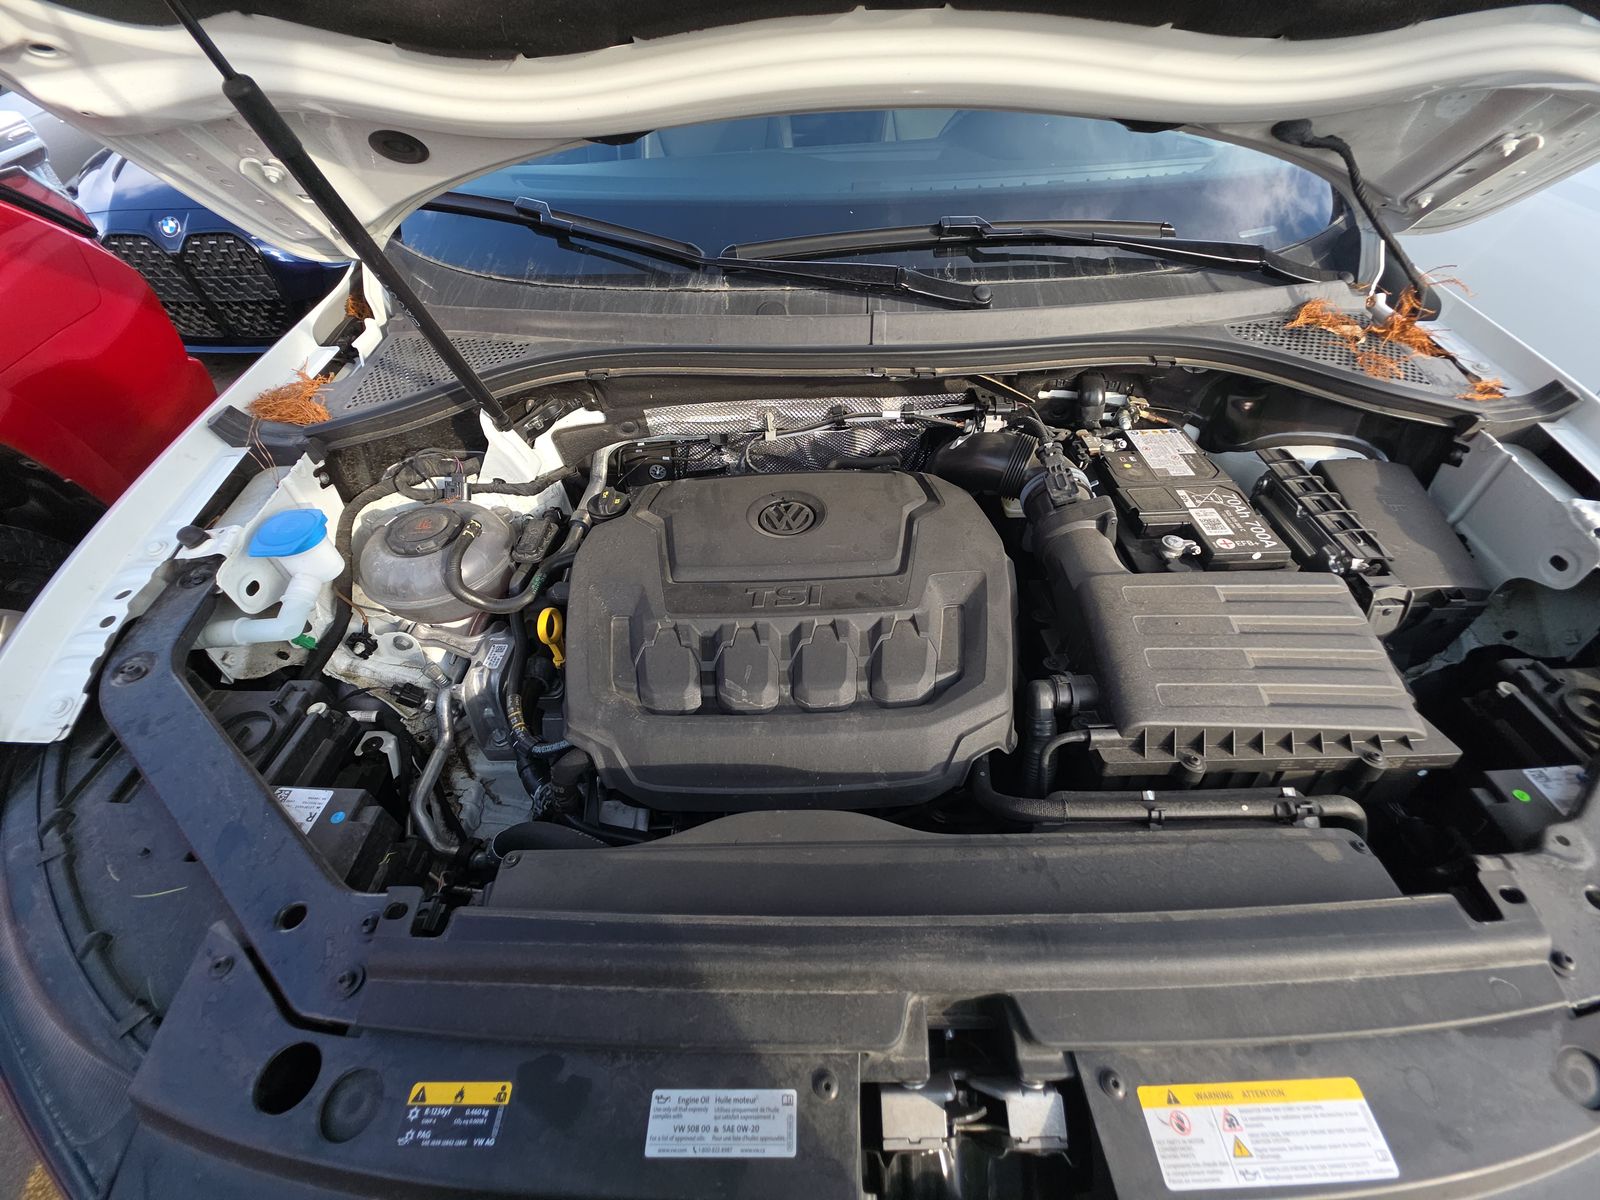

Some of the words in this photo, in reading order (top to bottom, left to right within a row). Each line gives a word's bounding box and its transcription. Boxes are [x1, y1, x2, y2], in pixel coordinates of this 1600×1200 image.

[1222, 493, 1251, 518] 70Ah
[1245, 520, 1278, 548] 700A
[745, 584, 823, 608] TSI
[305, 812, 318, 822] R
[1194, 1091, 1234, 1100] WARNING
[1241, 1088, 1286, 1098] ATTENTION
[677, 1096, 699, 1106] Engine
[700, 1096, 710, 1104] Oil
[715, 1096, 731, 1104] Huile
[424, 1107, 453, 1118] R-1234yf
[673, 1125, 686, 1133] VW
[687, 1125, 700, 1133] 508
[700, 1125, 711, 1133] 00
[713, 1125, 719, 1133] &
[722, 1125, 735, 1133] SAE
[736, 1125, 760, 1133] 0W-20
[416, 1130, 432, 1139] PAG
[473, 1138, 485, 1146] VW
